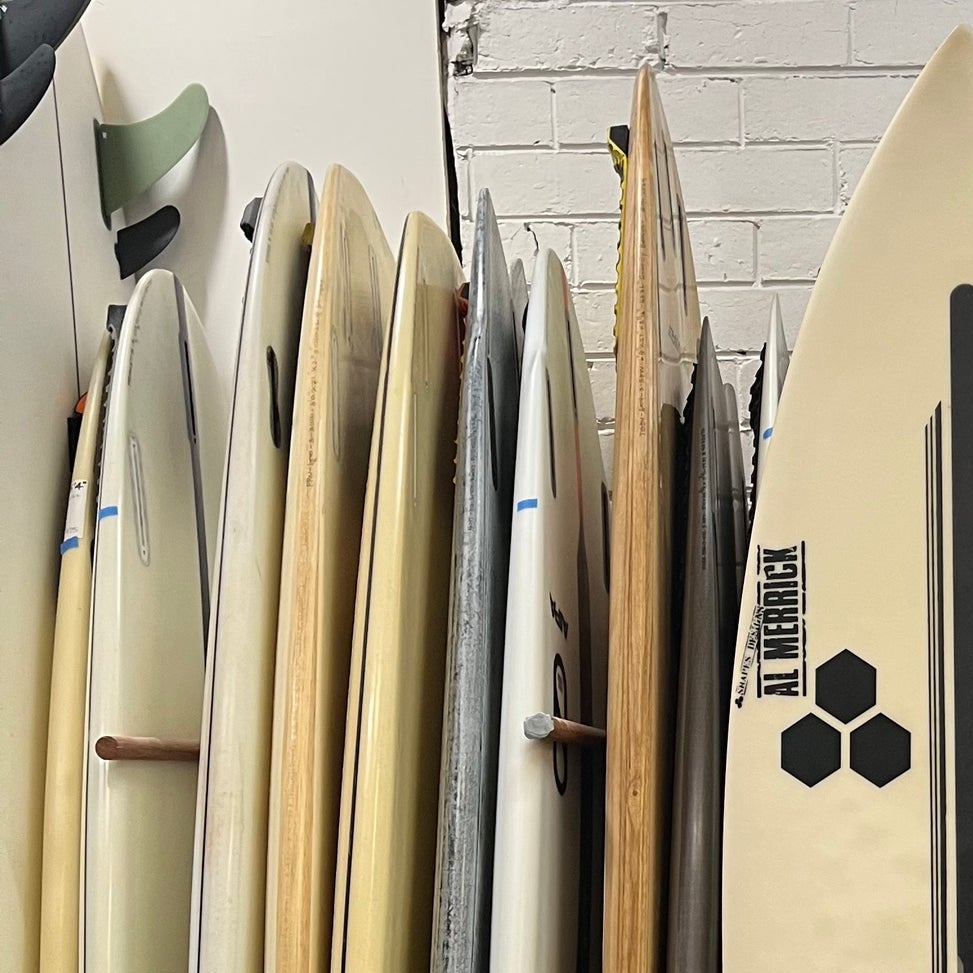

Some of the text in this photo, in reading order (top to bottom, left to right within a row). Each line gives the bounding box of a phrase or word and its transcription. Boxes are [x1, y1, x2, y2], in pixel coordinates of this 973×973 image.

[737, 606, 765, 695] SHAPES DESIGNS
[763, 545, 799, 697] AL MERRICK
